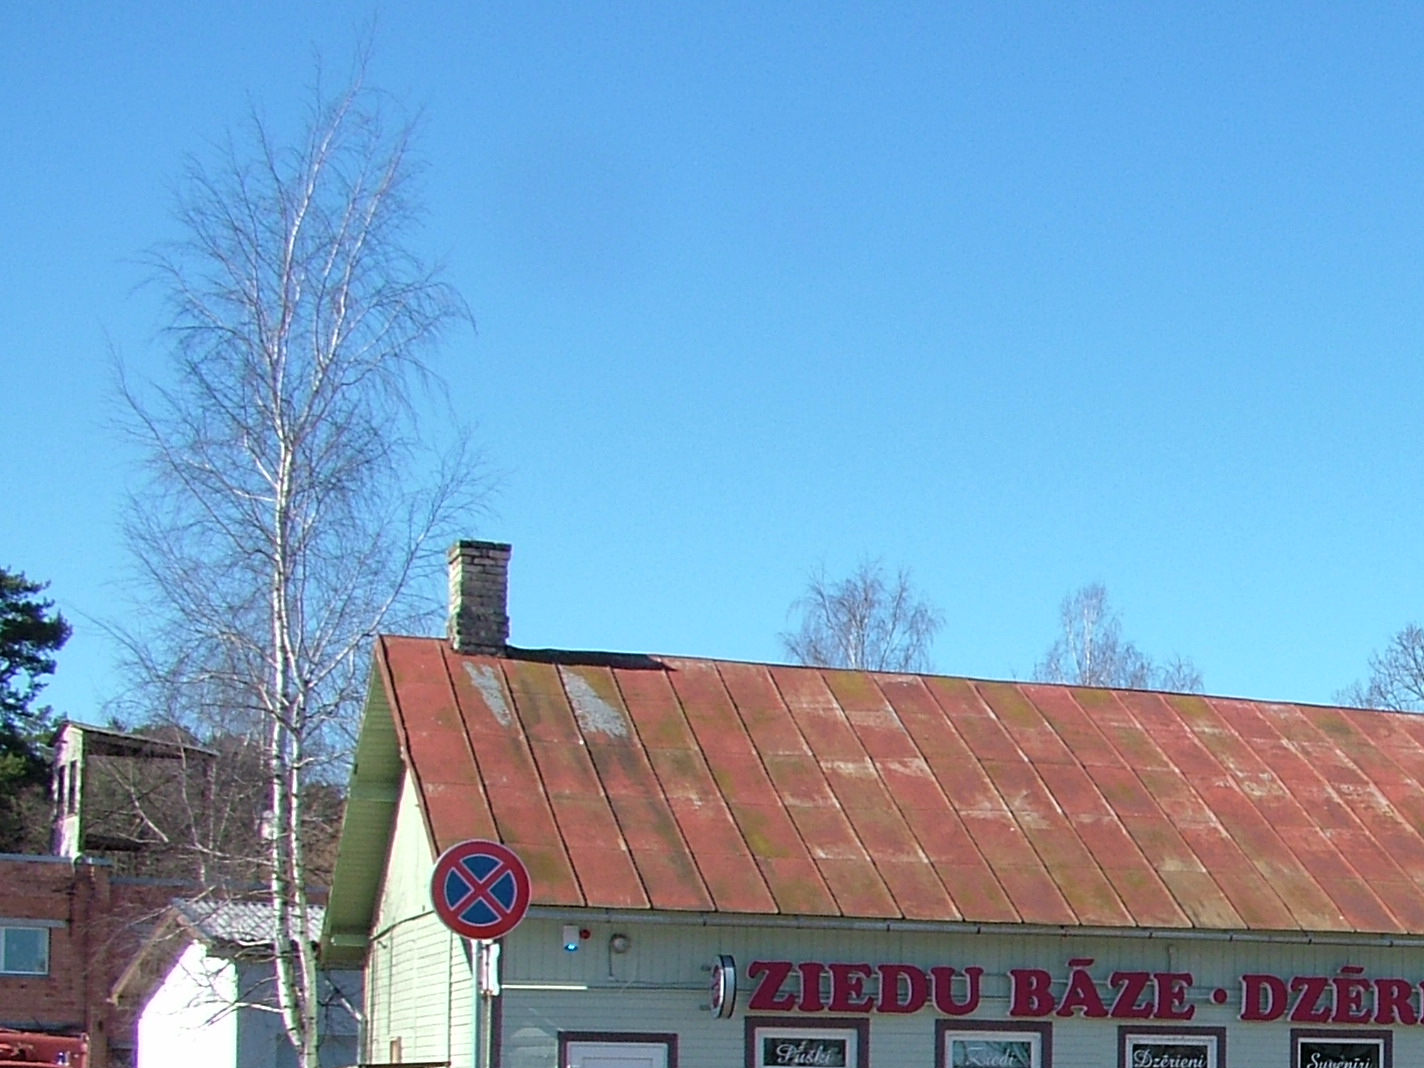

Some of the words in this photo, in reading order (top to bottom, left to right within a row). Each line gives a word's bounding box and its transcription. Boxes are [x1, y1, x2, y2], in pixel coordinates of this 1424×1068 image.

[748, 961, 983, 1016] ZIEDU
[1010, 958, 1195, 1021] BĀZE
[1133, 1049, 1206, 1068] Dzērieni
